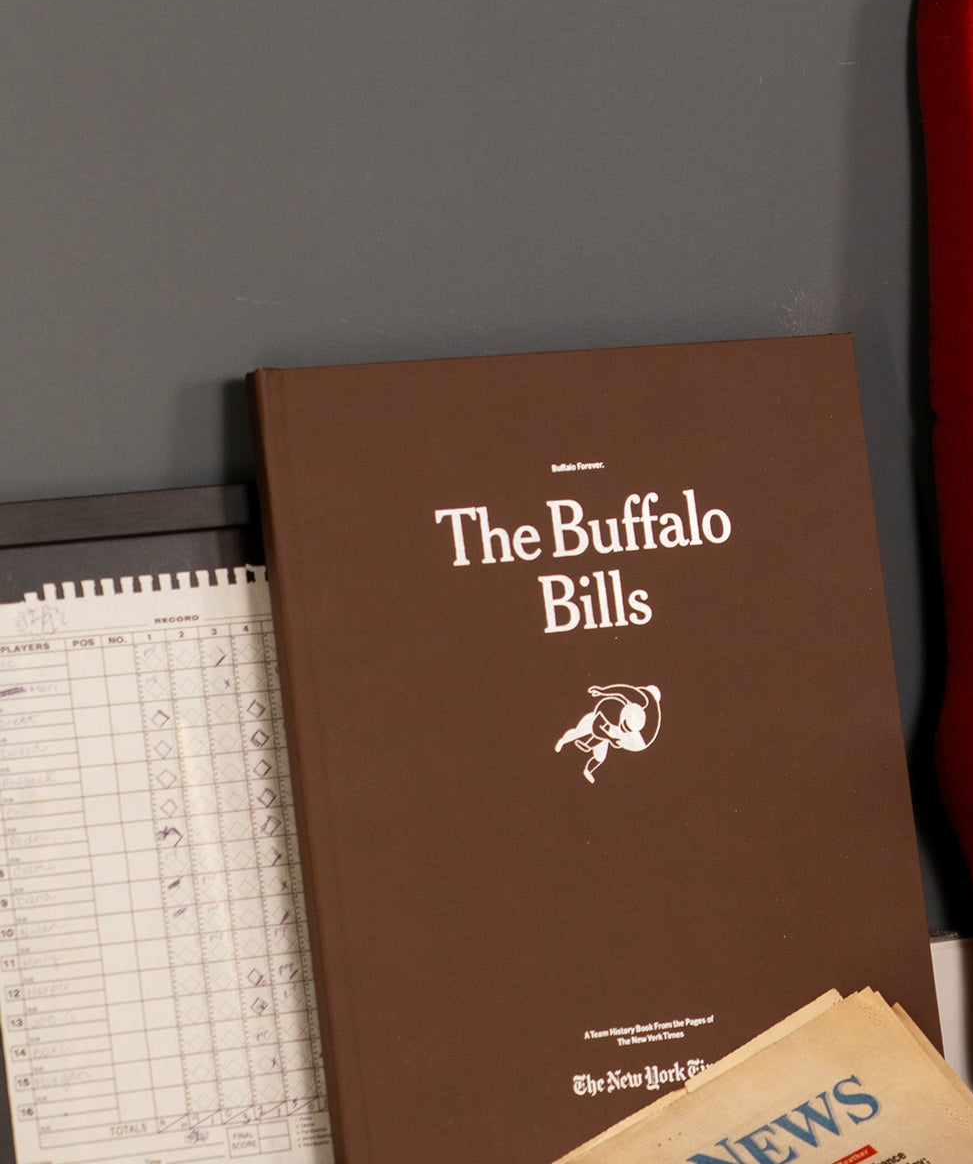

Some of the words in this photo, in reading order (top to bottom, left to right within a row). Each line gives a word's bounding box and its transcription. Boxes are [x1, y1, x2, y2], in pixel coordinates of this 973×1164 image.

[551, 463, 576, 473] Buffalo
[577, 461, 605, 471] Forever.
[435, 506, 542, 567] The
[546, 489, 732, 558] Buffalo
[538, 569, 653, 634] Bills
[154, 615, 200, 624] RECORD
[0, 642, 51, 654] PLAYERS
[72, 638, 95, 648] POS
[108, 636, 127, 645] NO.
[178, 630, 185, 639] 2
[210, 627, 218, 636] 3
[242, 624, 250, 633] 4
[8, 989, 21, 998] 12
[584, 1031, 591, 1040] A
[591, 1029, 609, 1039] Team
[609, 1026, 636, 1037] History
[635, 1023, 653, 1034] Book
[654, 1021, 673, 1032] From
[673, 1019, 685, 1029] the
[685, 1017, 706, 1029] Pages
[706, 1014, 715, 1024] of
[617, 1036, 631, 1047] The
[631, 1035, 647, 1045] New
[647, 1033, 664, 1043] York
[663, 1030, 685, 1041] Times
[14, 1048, 27, 1057] 14
[573, 1072, 604, 1097] The
[607, 1069, 643, 1094] New
[644, 1061, 687, 1092] York
[110, 1122, 148, 1136] TOTALS
